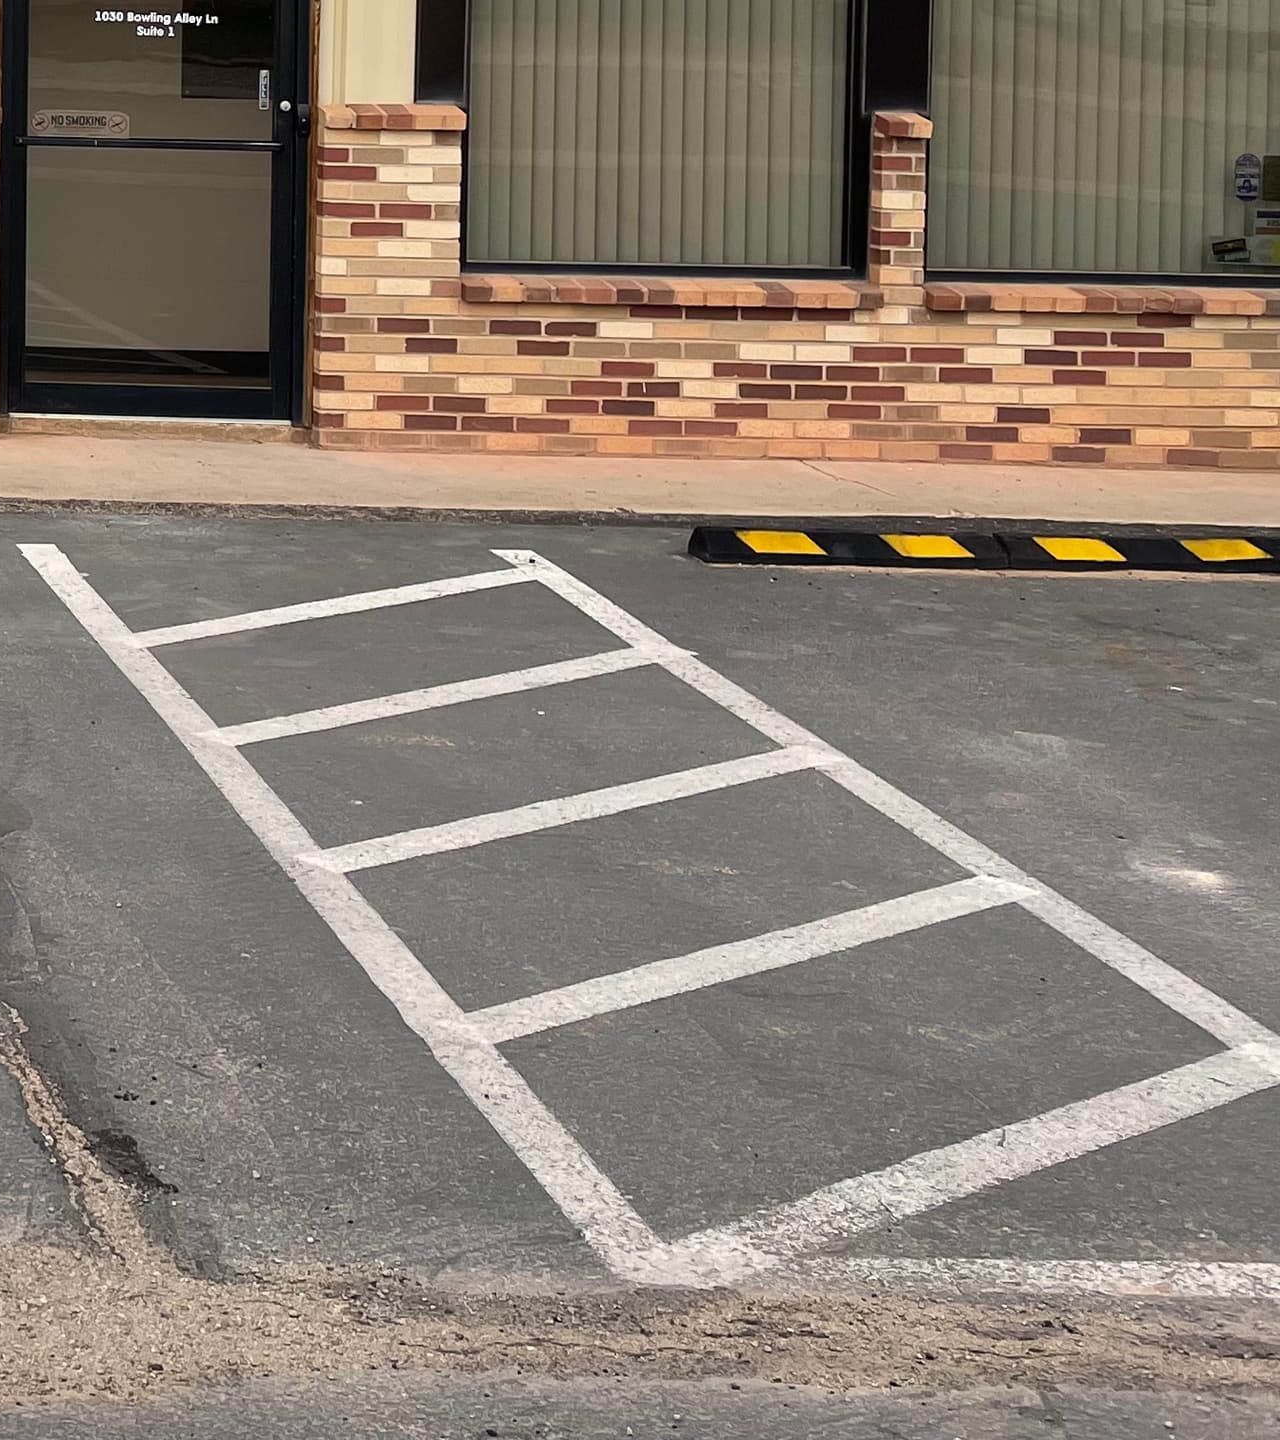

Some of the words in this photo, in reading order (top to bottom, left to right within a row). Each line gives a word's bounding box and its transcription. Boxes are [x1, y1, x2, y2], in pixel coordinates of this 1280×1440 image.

[95, 10, 125, 22] 1030
[127, 11, 172, 26] Bowling
[174, 12, 203, 27] Alley
[205, 13, 219, 25] Ln
[136, 25, 165, 37] Suite
[168, 26, 175, 37] 1
[51, 114, 64, 126] NO
[65, 115, 107, 128] SMOKING
